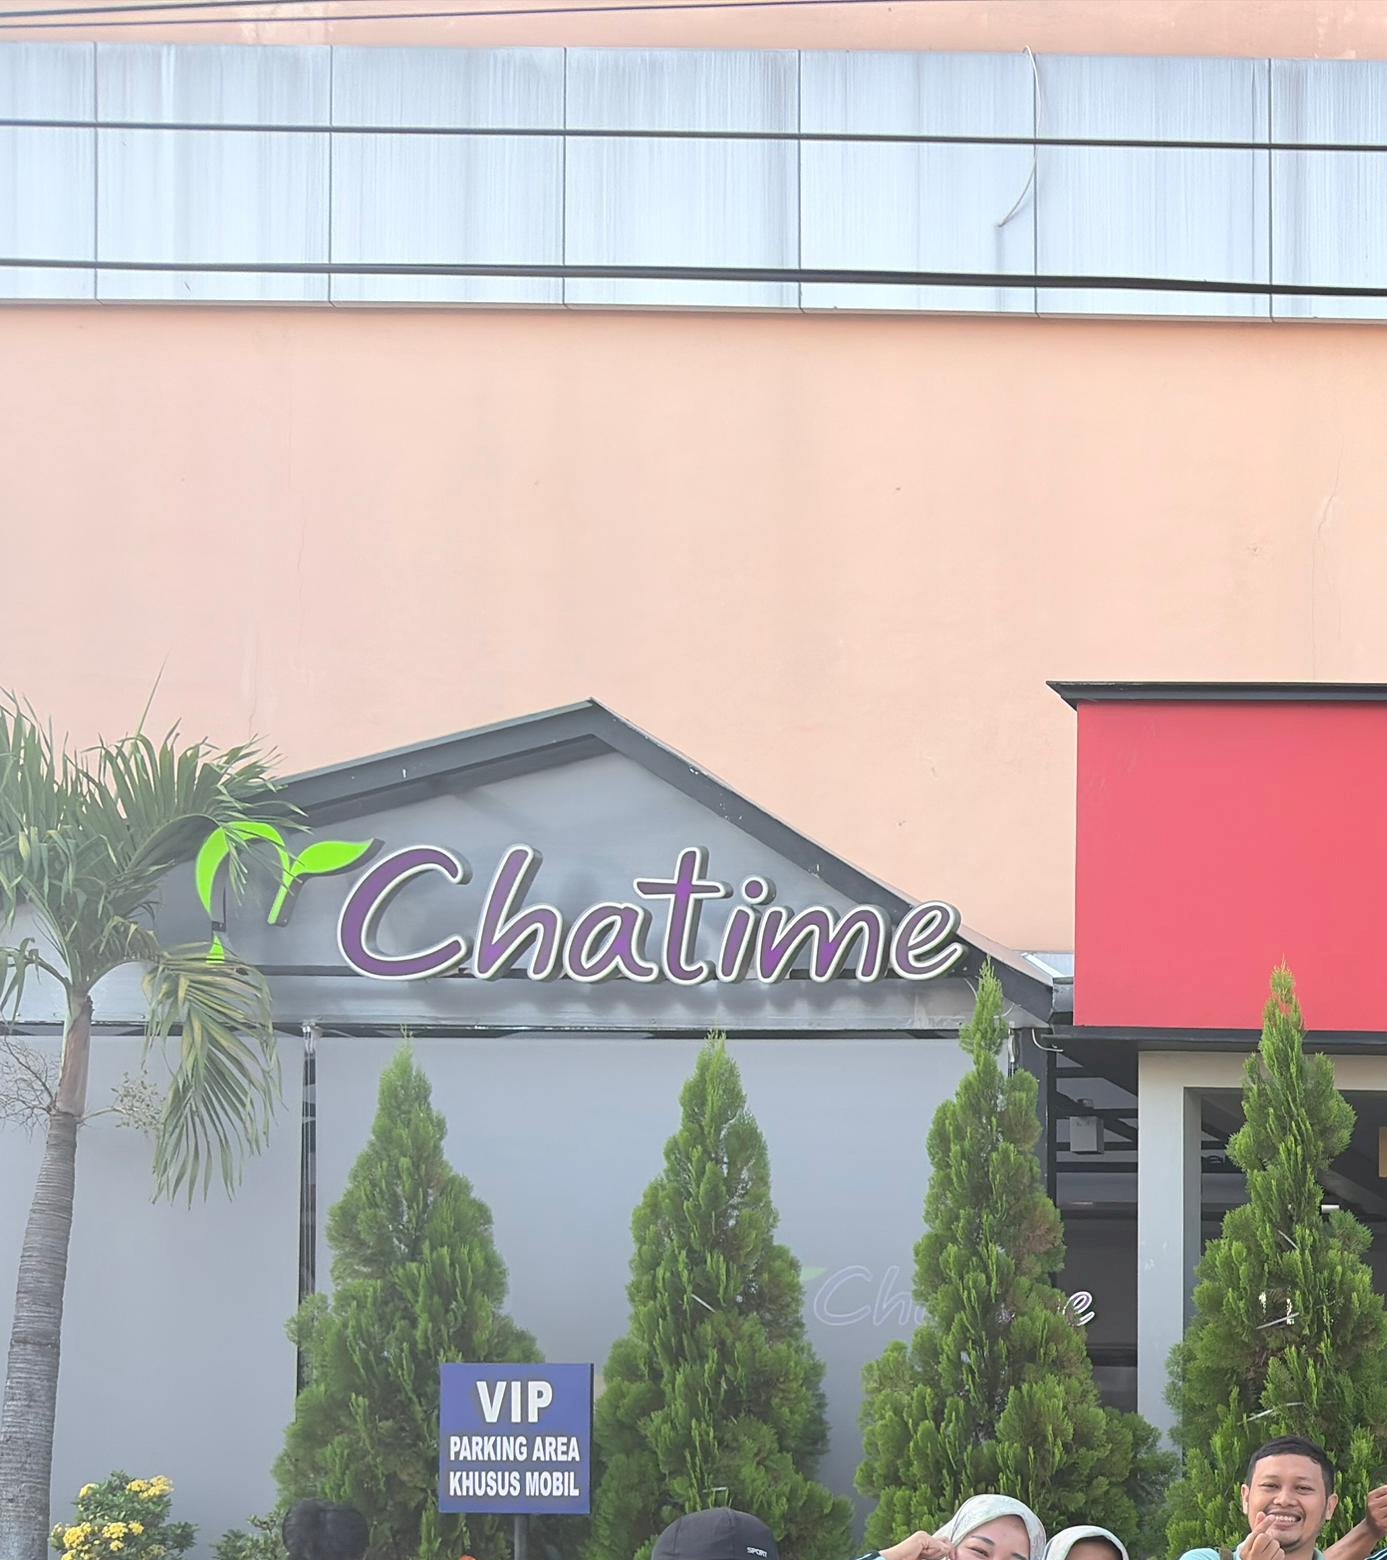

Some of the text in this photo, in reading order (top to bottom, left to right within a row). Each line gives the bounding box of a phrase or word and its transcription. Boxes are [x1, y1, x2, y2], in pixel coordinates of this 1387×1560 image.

[338, 845, 964, 983] Chatime
[476, 1381, 553, 1423] VIP
[450, 1436, 580, 1462] PARKING AREA
[450, 1471, 579, 1497] KHUSUS MOBIL
[746, 1546, 768, 1558] SPORT
